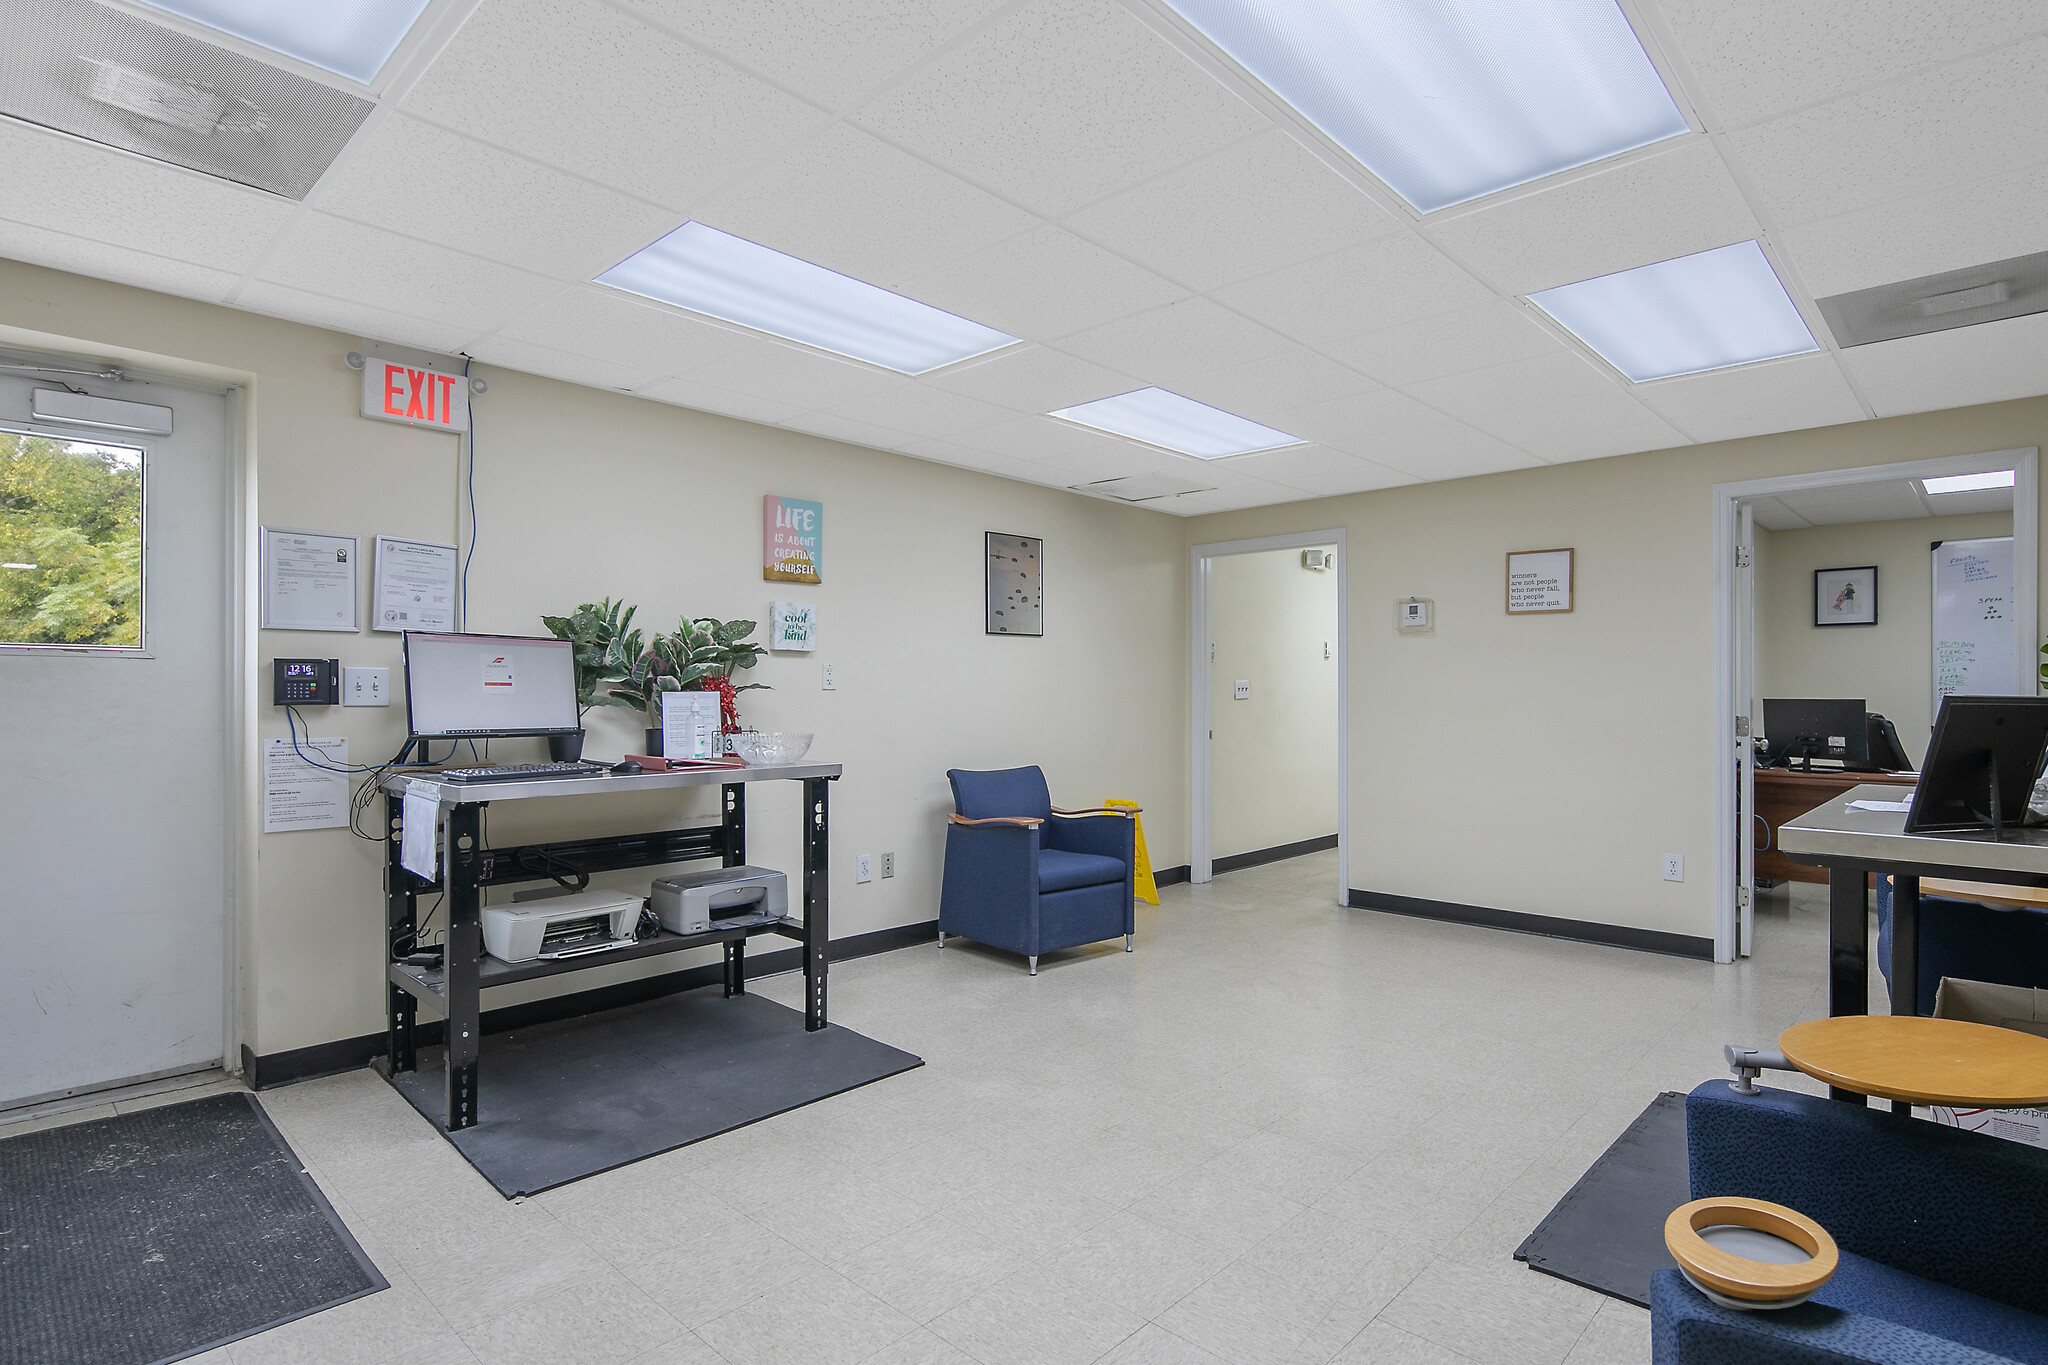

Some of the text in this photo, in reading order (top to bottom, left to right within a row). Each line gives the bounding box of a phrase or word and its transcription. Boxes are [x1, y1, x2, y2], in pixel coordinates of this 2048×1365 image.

[384, 364, 455, 424] EXIT
[776, 504, 815, 531] LIFE
[775, 533, 816, 547] IS ABOUT
[774, 547, 815, 561] CREATING
[774, 562, 815, 575] YOURSELF
[784, 612, 807, 623] cool
[784, 629, 807, 641] kind
[725, 739, 733, 751] 3
